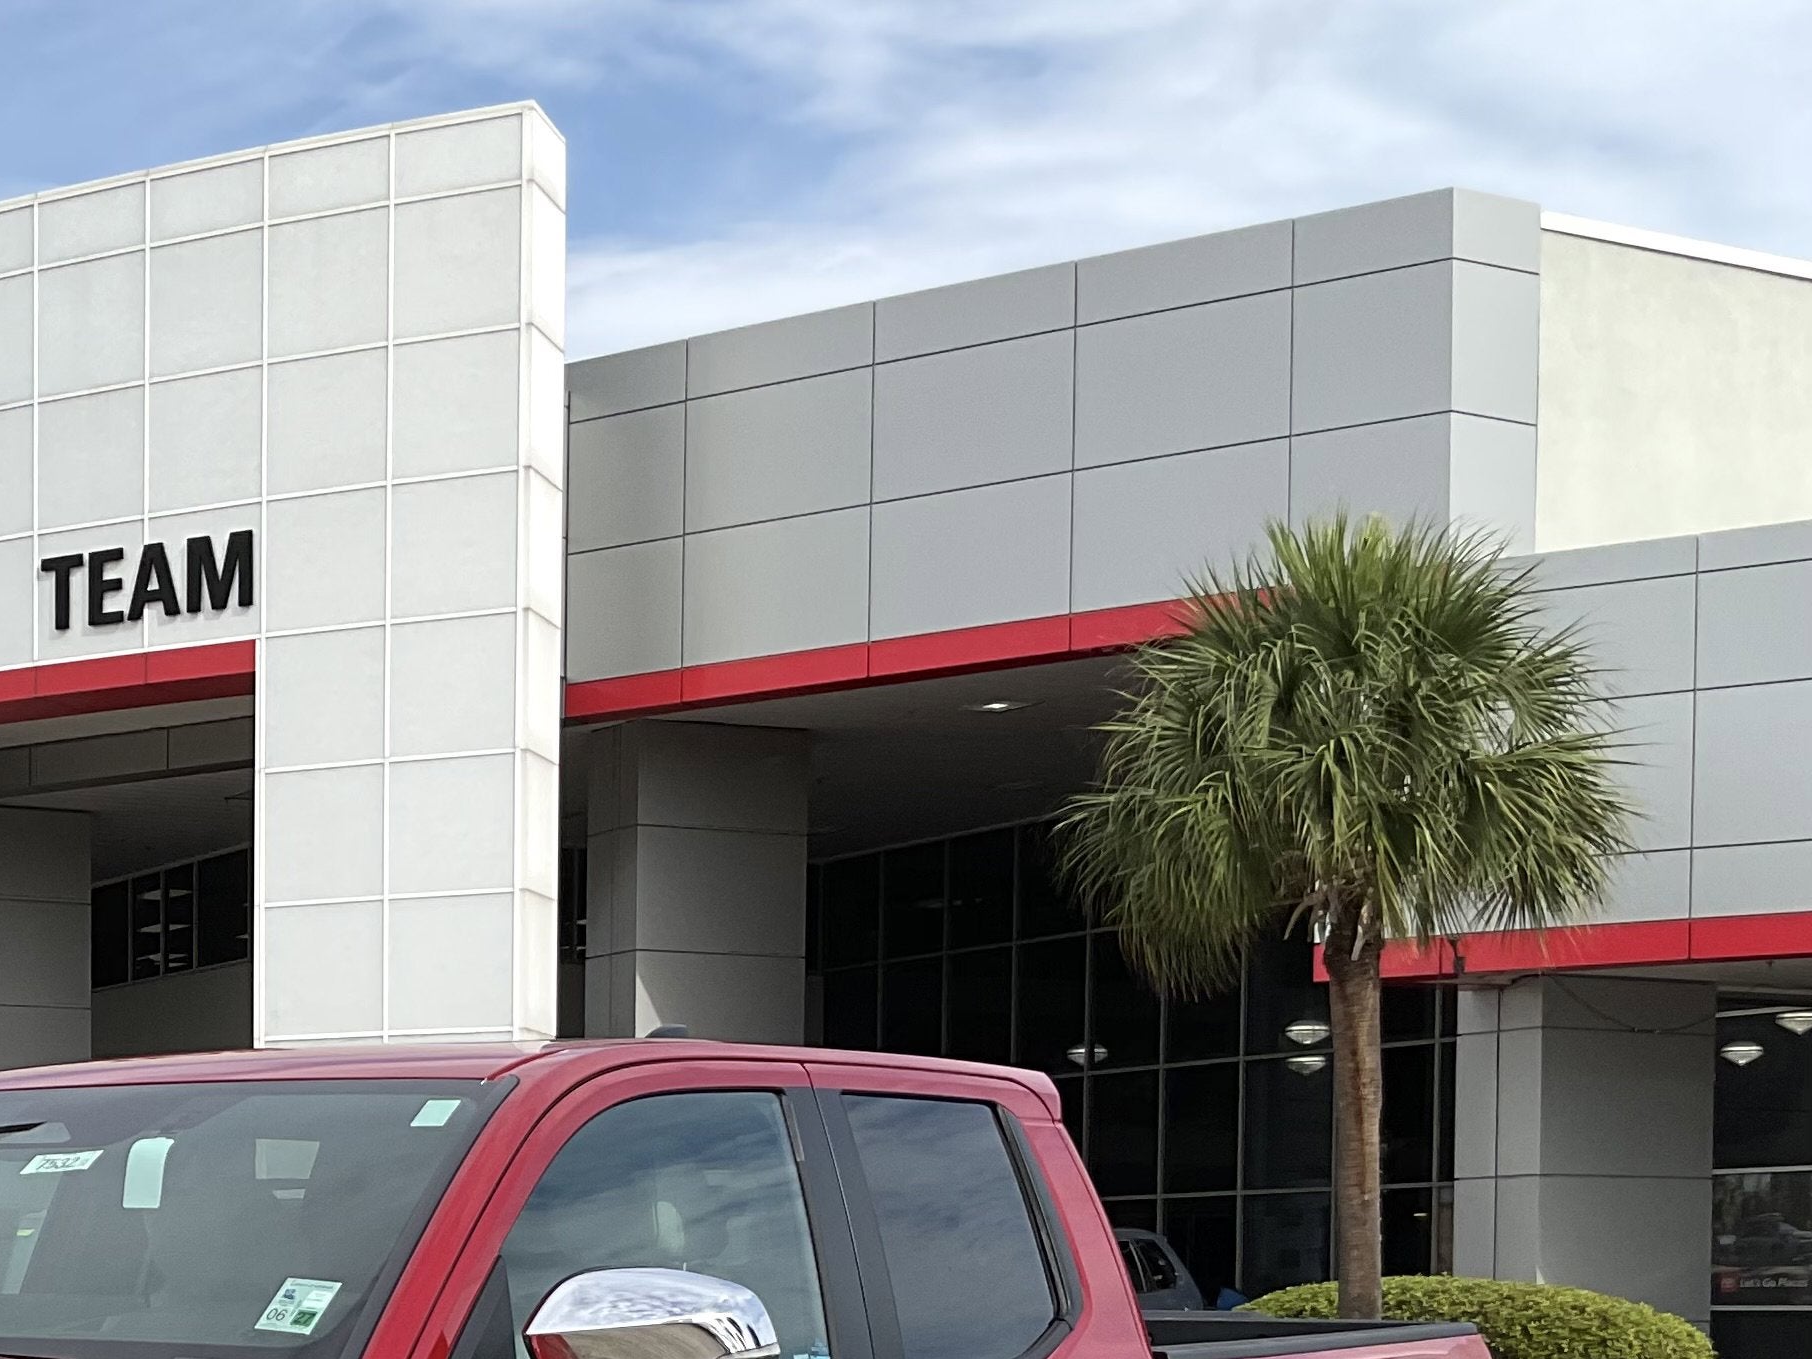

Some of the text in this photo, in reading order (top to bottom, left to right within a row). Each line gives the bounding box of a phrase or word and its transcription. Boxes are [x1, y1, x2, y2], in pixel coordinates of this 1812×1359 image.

[41, 529, 254, 630] TEAM
[266, 1308, 288, 1321] 06
[291, 1311, 317, 1327] 27
